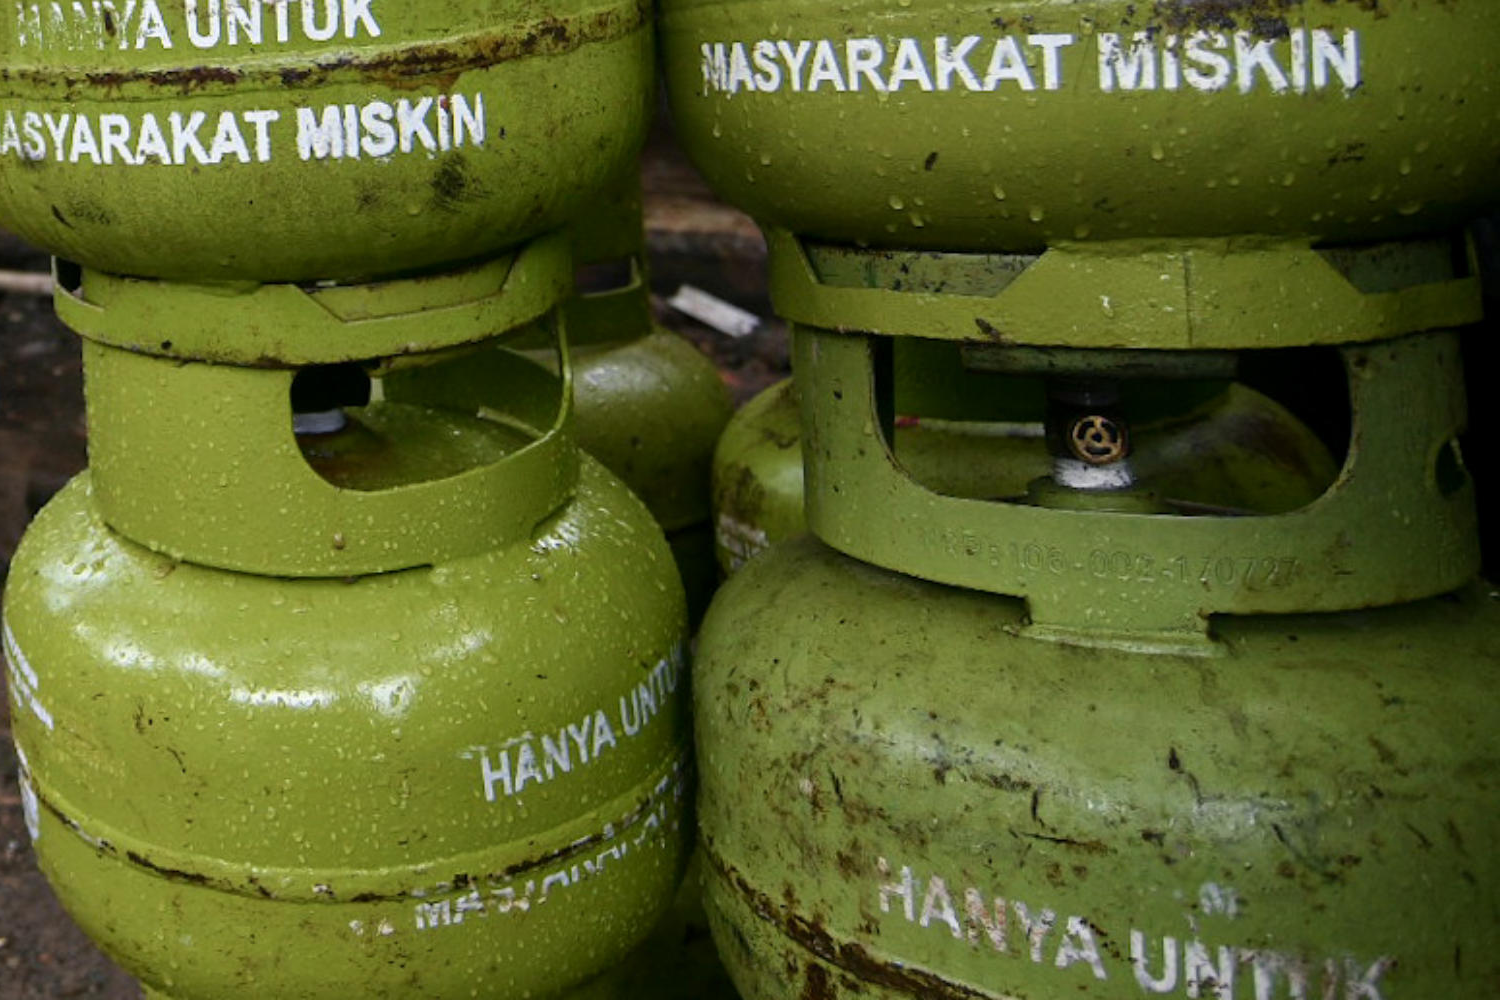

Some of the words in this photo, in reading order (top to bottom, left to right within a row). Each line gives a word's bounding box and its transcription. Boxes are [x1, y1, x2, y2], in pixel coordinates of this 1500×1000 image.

[701, 34, 1074, 97] MASYARAKAT
[1097, 24, 1362, 98] MISKIN
[296, 92, 486, 162] MISKIN
[481, 708, 617, 801] HANYA
[618, 640, 681, 736] UNTU
[877, 856, 1108, 980] HANYA
